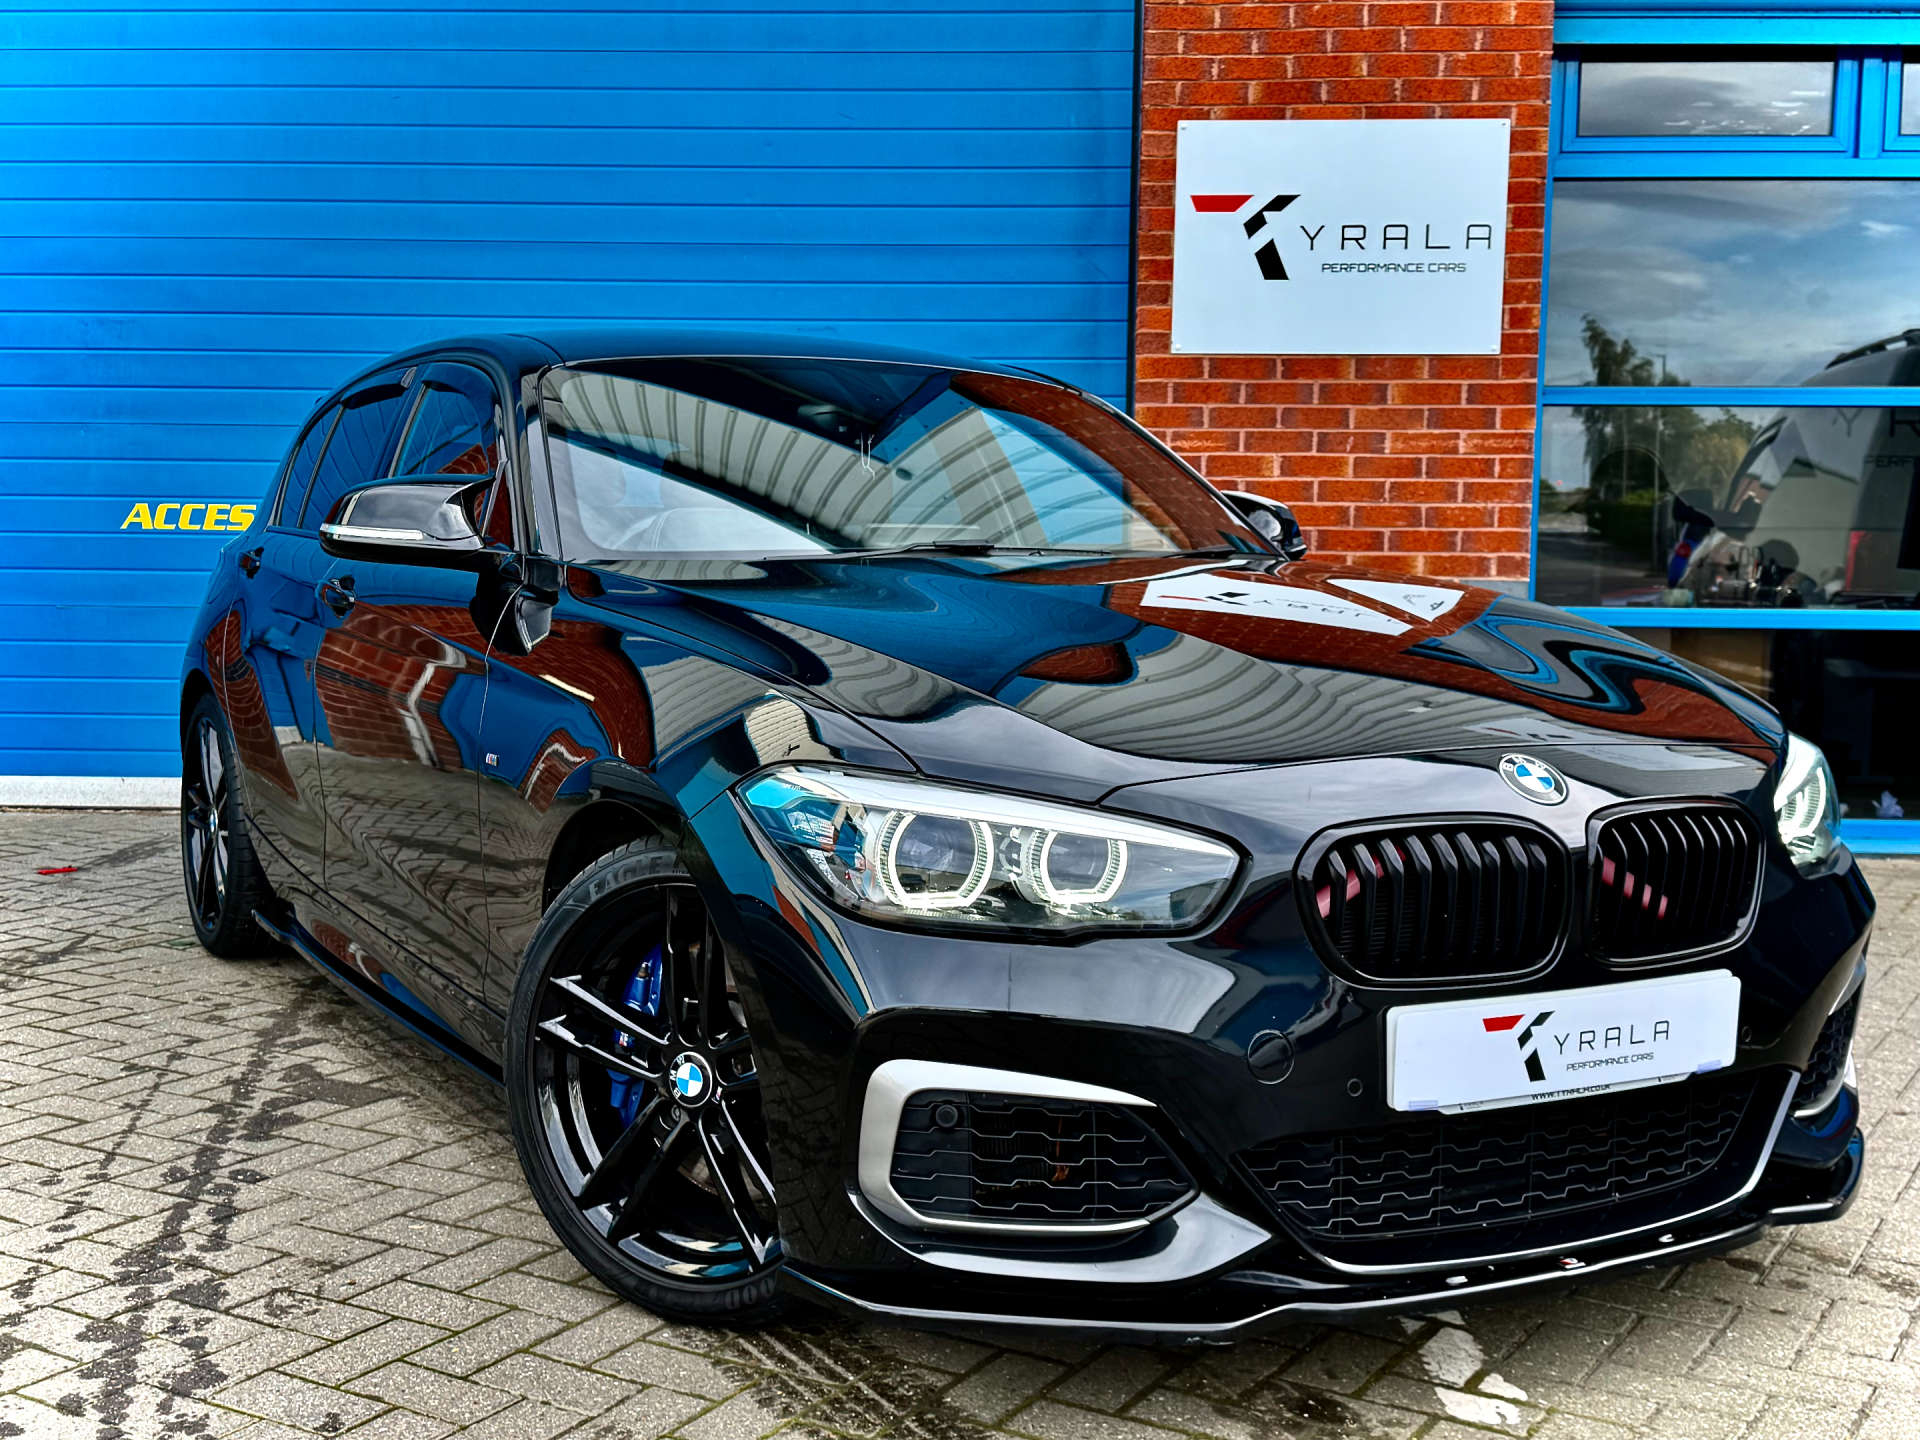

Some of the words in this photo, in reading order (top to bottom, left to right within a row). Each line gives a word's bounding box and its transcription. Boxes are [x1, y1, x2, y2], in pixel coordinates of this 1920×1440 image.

[1321, 262, 1424, 273] PERFORMANCE
[1428, 262, 1467, 273] CARS
[1566, 1056, 1629, 1072] PERFORMANCE
[1631, 1052, 1655, 1063] CARS
